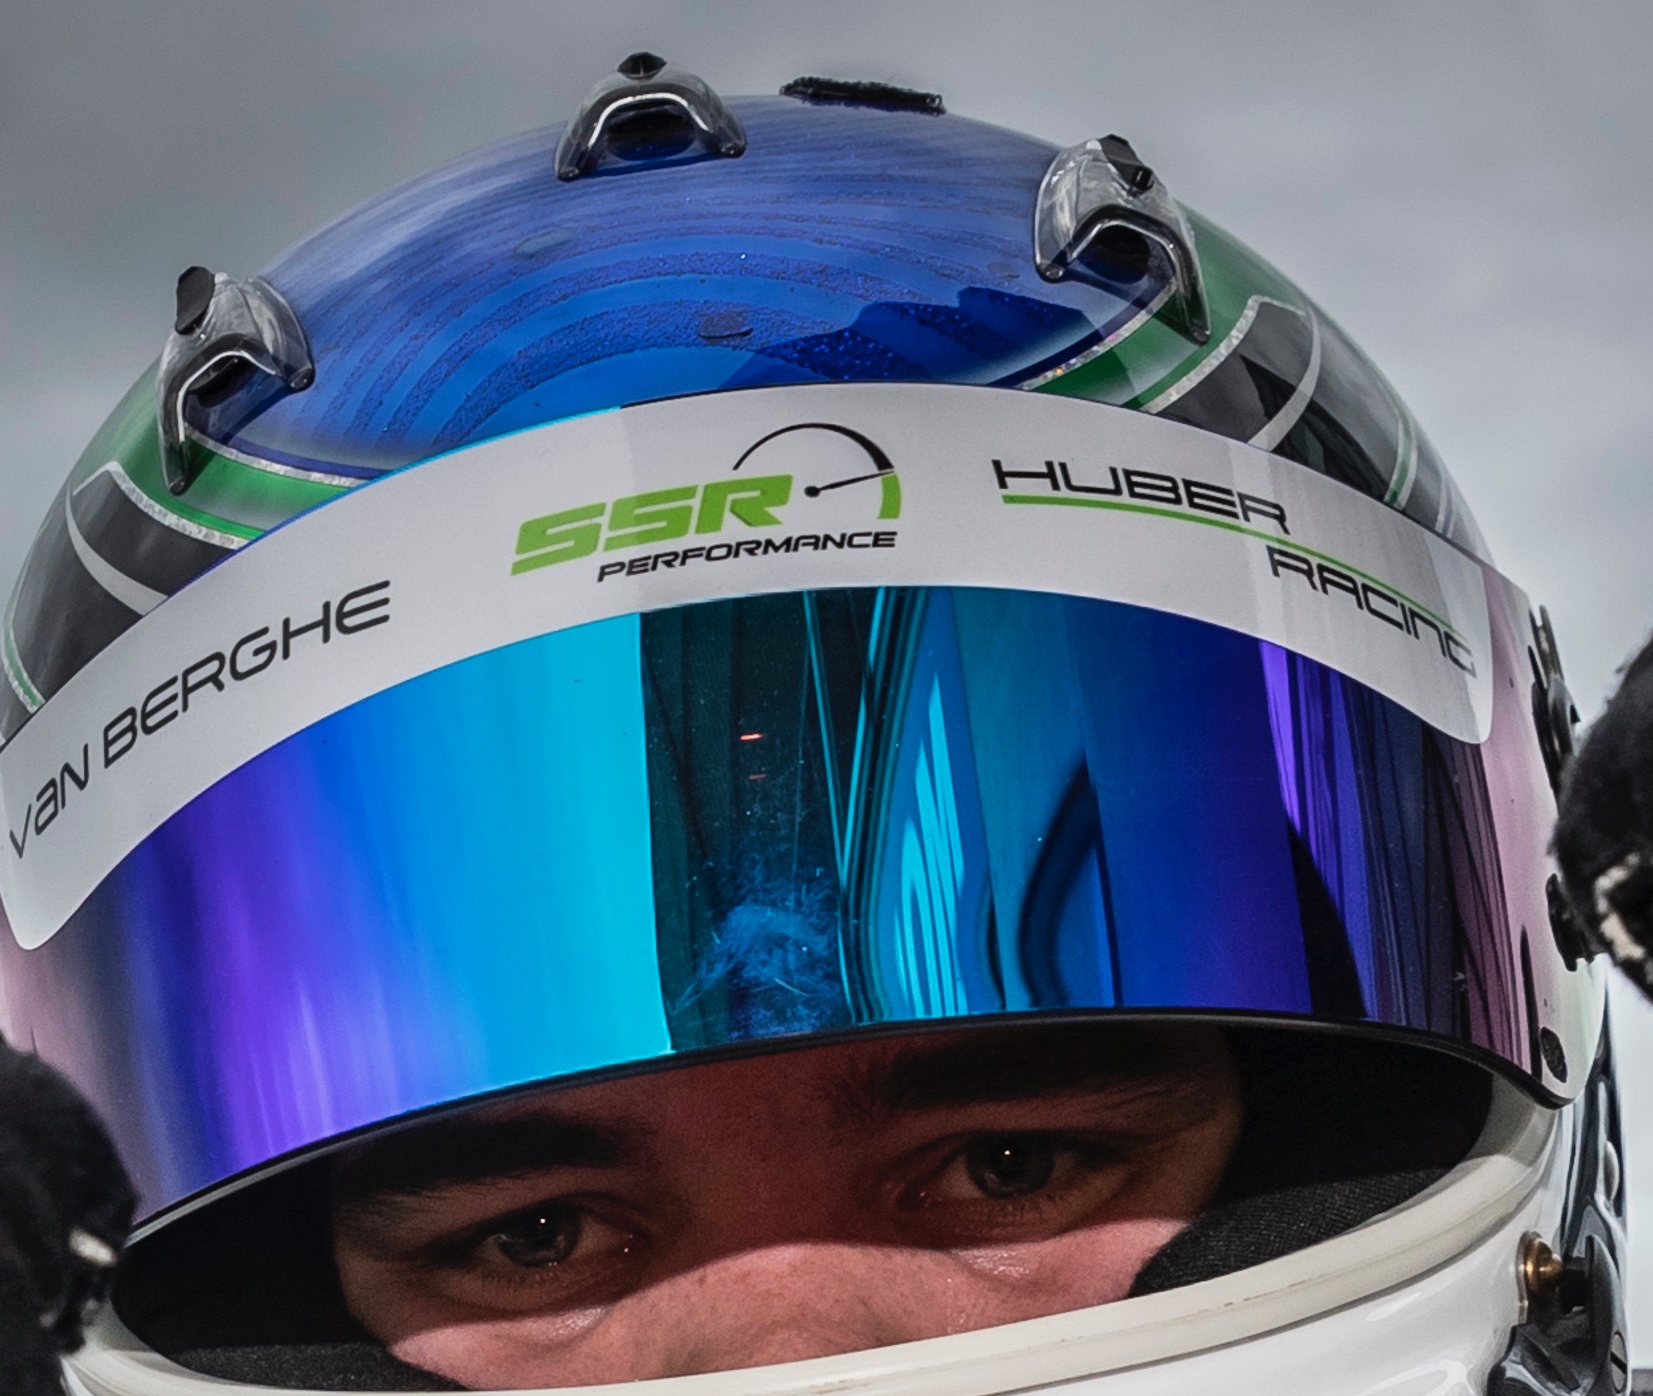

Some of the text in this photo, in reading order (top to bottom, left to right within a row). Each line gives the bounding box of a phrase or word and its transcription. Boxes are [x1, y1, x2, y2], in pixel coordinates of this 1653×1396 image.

[510, 474, 793, 576] SSR
[991, 459, 1291, 535] HUBER
[597, 531, 898, 582] PERFORMANCE
[1266, 545, 1477, 678] RACING
[103, 580, 391, 769] BERGHE
